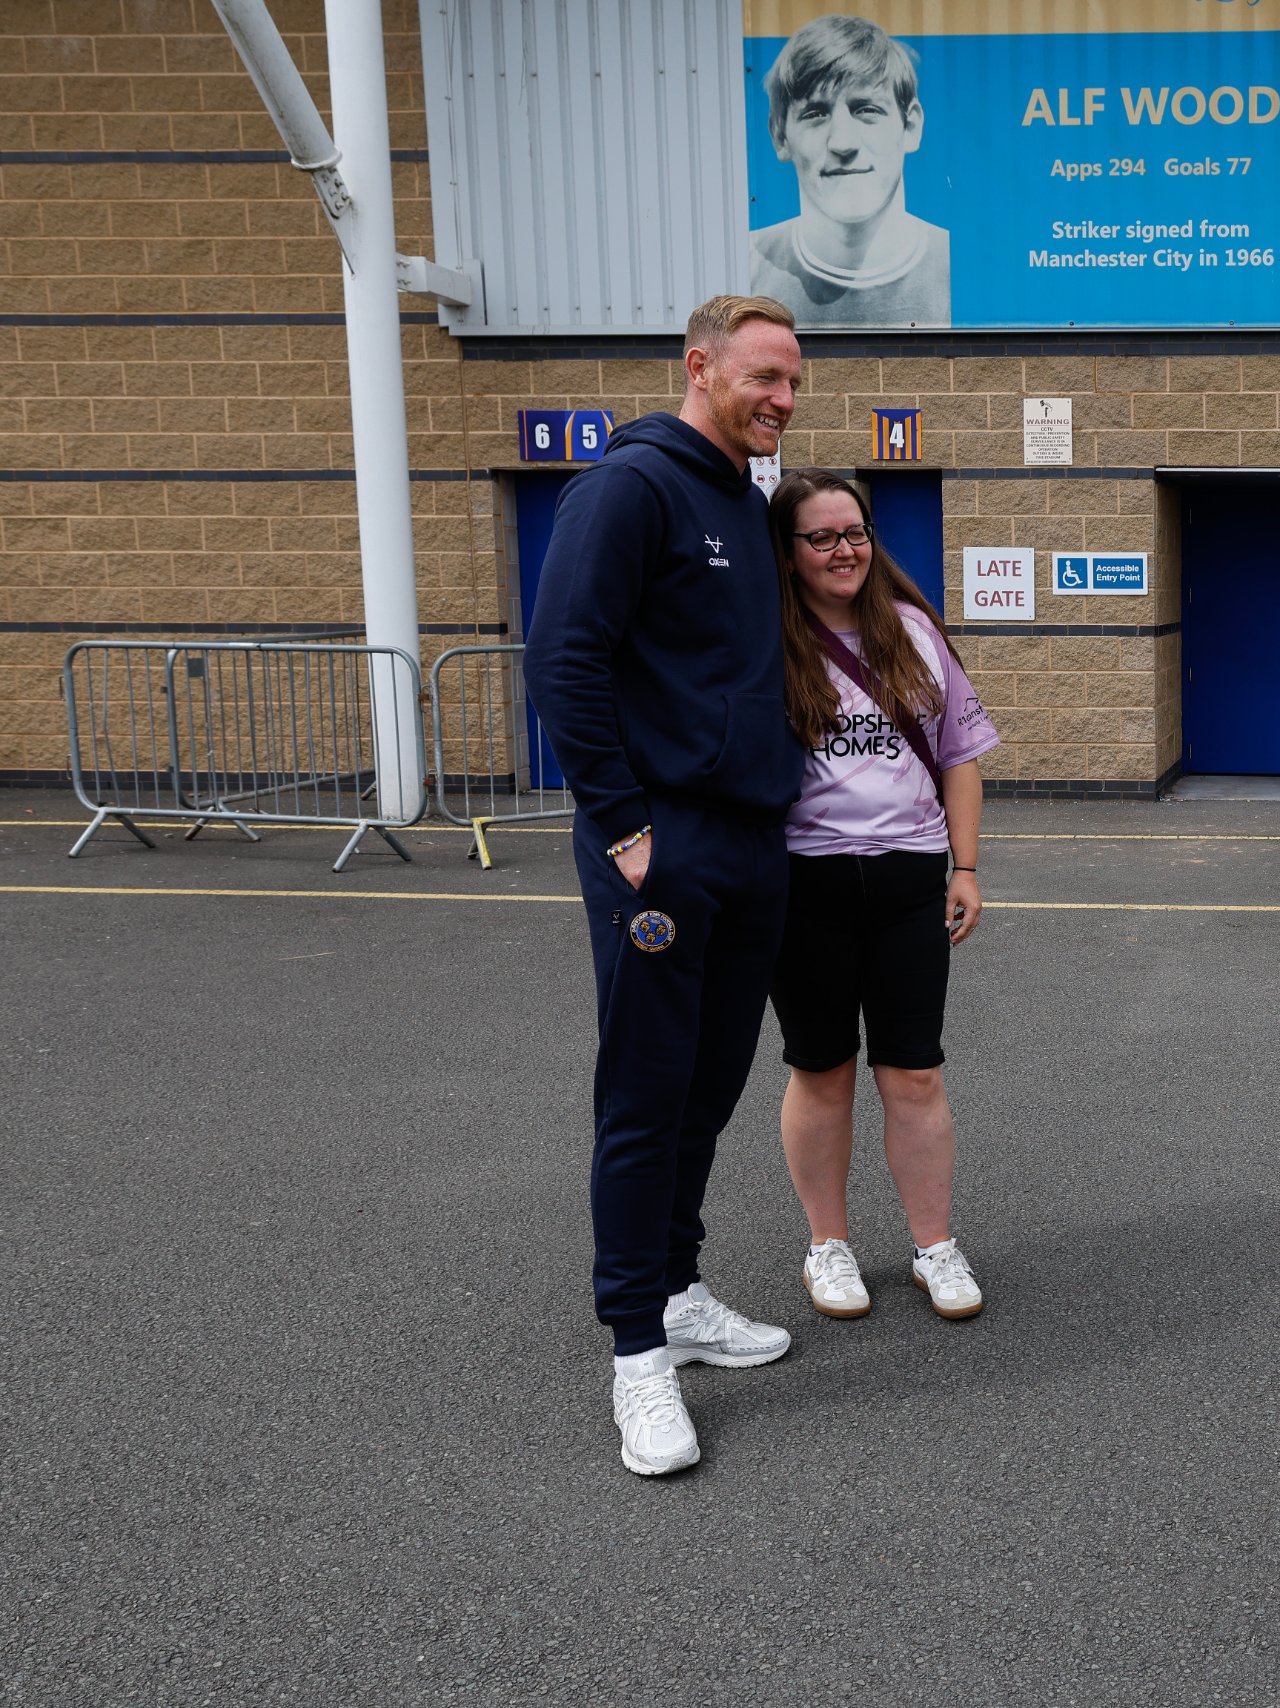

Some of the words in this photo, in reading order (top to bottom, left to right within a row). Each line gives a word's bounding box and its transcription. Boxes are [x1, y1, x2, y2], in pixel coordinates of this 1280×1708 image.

[1021, 87, 1106, 126] ALF
[1120, 85, 1280, 126] WOOD
[1050, 159, 1103, 182] Apps
[1108, 158, 1146, 176] 294
[1163, 157, 1221, 176] Goals
[1227, 157, 1252, 175] 77
[1052, 220, 1121, 239] Striker
[1126, 219, 1194, 243] signed
[1200, 219, 1250, 238] from
[1028, 250, 1148, 268] Manchester
[1152, 248, 1194, 272] City
[1199, 248, 1218, 266] in
[1225, 248, 1275, 266] 1966
[534, 422, 551, 450] 6
[582, 423, 598, 450] 5
[888, 423, 905, 449] 4
[708, 557, 730, 567] OXEN
[977, 560, 1022, 577] LATE
[1096, 564, 1140, 572] Accessible
[1096, 574, 1118, 583] Entry
[1119, 574, 1140, 582] Point
[974, 590, 1025, 607] GATE
[809, 735, 901, 761] HOMES
